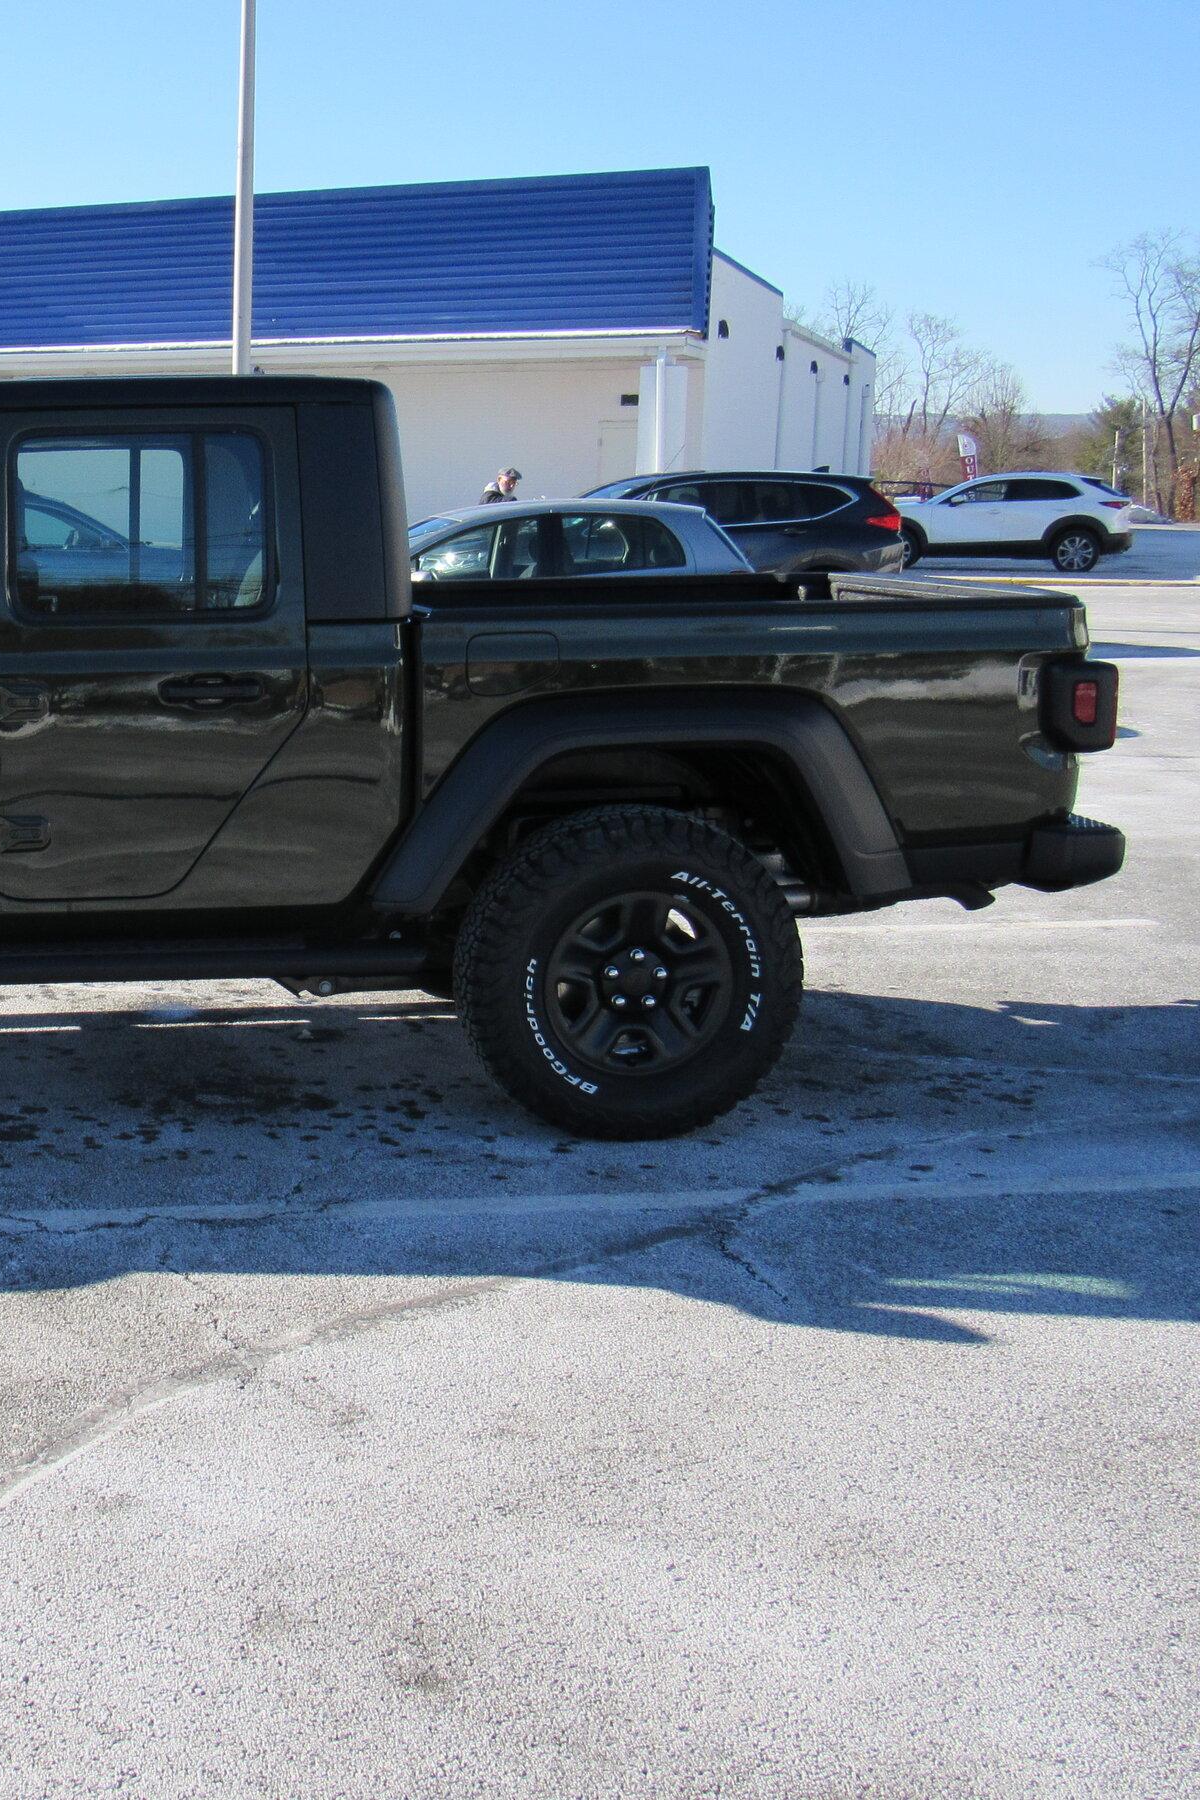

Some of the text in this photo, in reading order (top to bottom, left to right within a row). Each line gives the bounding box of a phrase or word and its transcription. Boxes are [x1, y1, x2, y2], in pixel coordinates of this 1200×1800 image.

[523, 957, 599, 1095] BFGoodrich
[670, 870, 763, 1032] All-Terrain T/A
